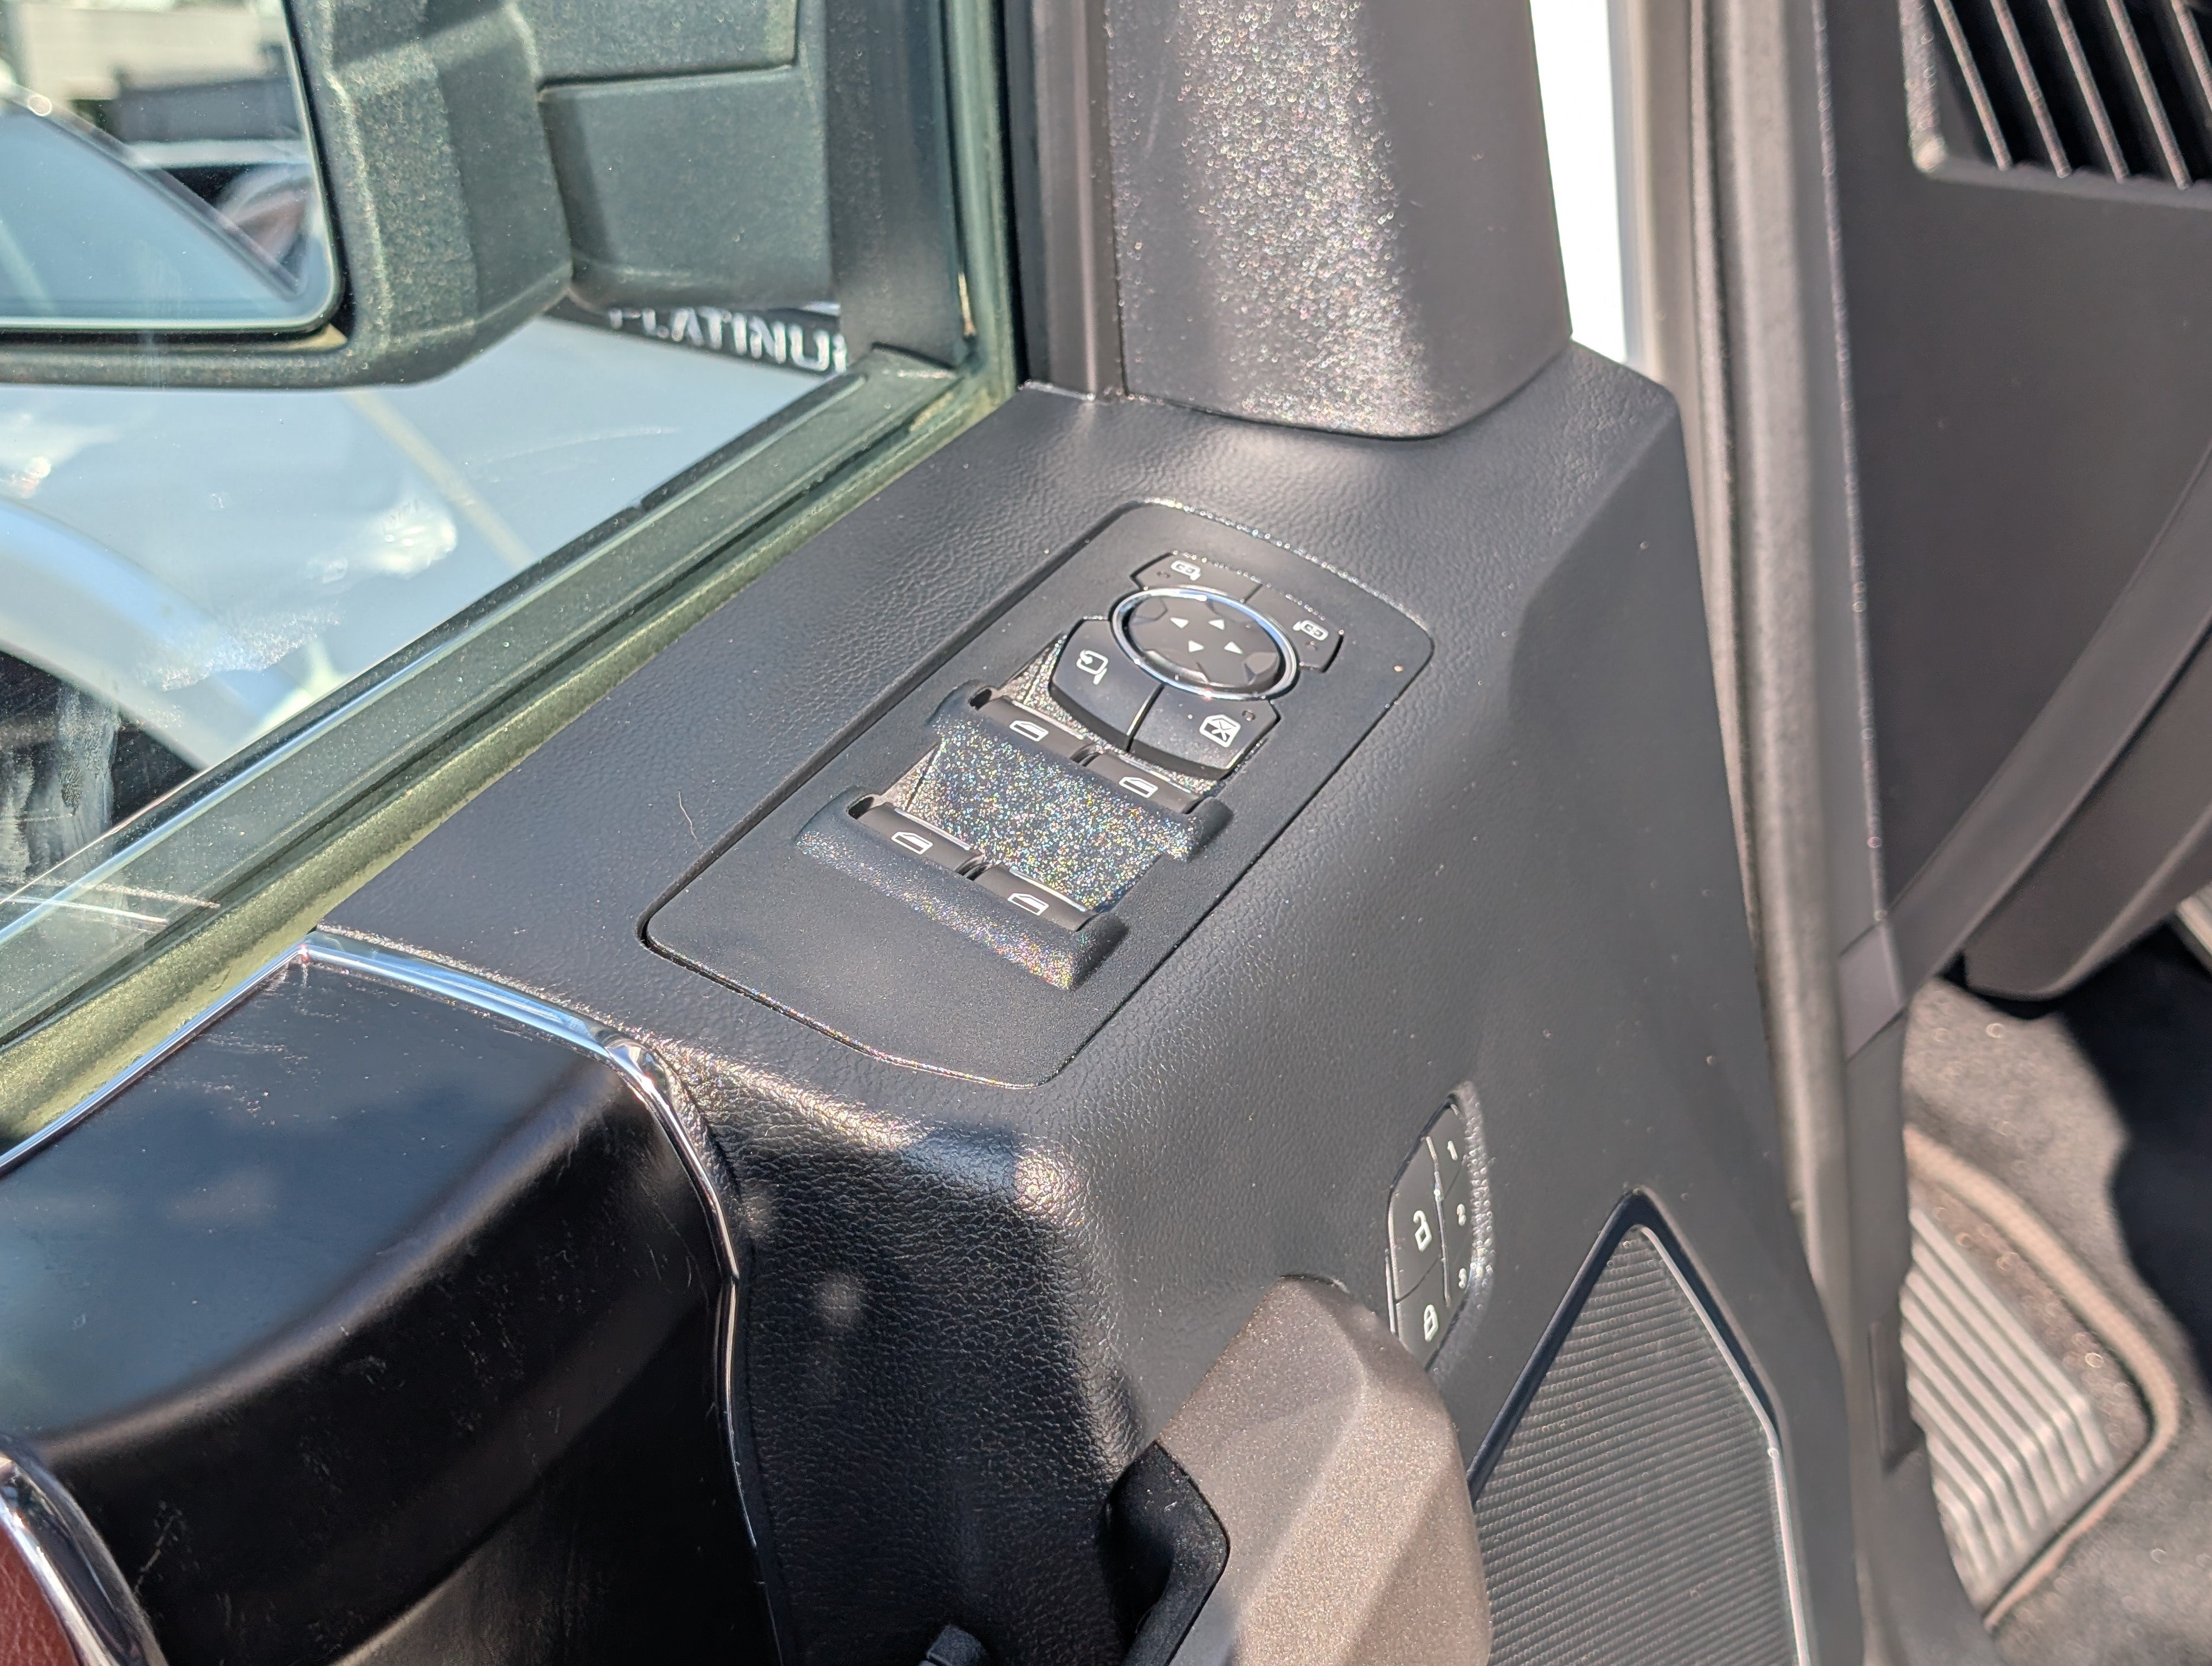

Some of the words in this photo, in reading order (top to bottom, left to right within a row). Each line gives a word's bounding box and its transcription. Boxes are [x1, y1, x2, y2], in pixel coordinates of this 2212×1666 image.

[1447, 1140, 1458, 1161] 1
[1456, 1203, 1467, 1226] 2
[1458, 1267, 1467, 1289] 3
